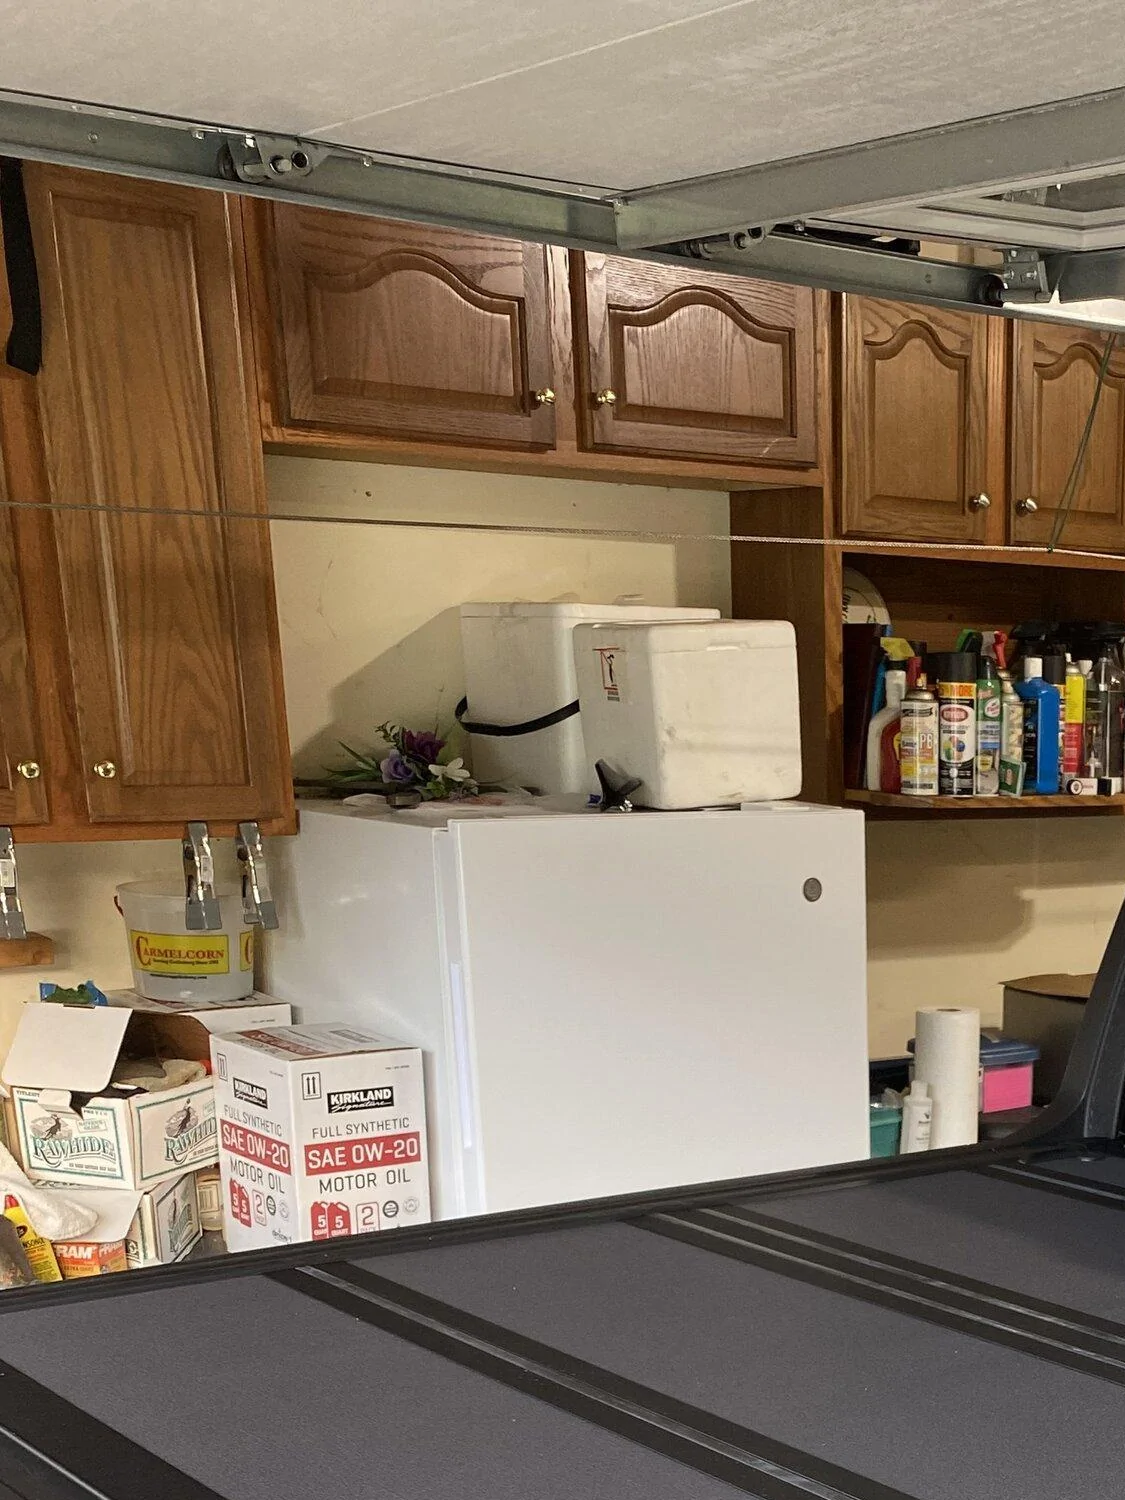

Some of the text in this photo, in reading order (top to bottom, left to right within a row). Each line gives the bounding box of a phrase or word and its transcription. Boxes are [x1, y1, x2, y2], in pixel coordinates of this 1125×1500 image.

[136, 935, 225, 966] CARMELCORN
[330, 1088, 393, 1106] KIRKLAND
[331, 1100, 393, 1113] Signature
[224, 1104, 283, 1137] FULL SYNTHETIC
[312, 1117, 411, 1139] FULL SYNTHETIC
[164, 1117, 217, 1165] RAWHID
[223, 1124, 245, 1152] SAE
[308, 1146, 347, 1169] SAE
[230, 1156, 285, 1194] MOTOR OIL
[319, 1168, 412, 1194] MOTOR OIL
[255, 1194, 263, 1215] 2
[361, 1205, 375, 1226] 2
[317, 1214, 326, 1228] 5
[335, 1215, 344, 1229] 5
